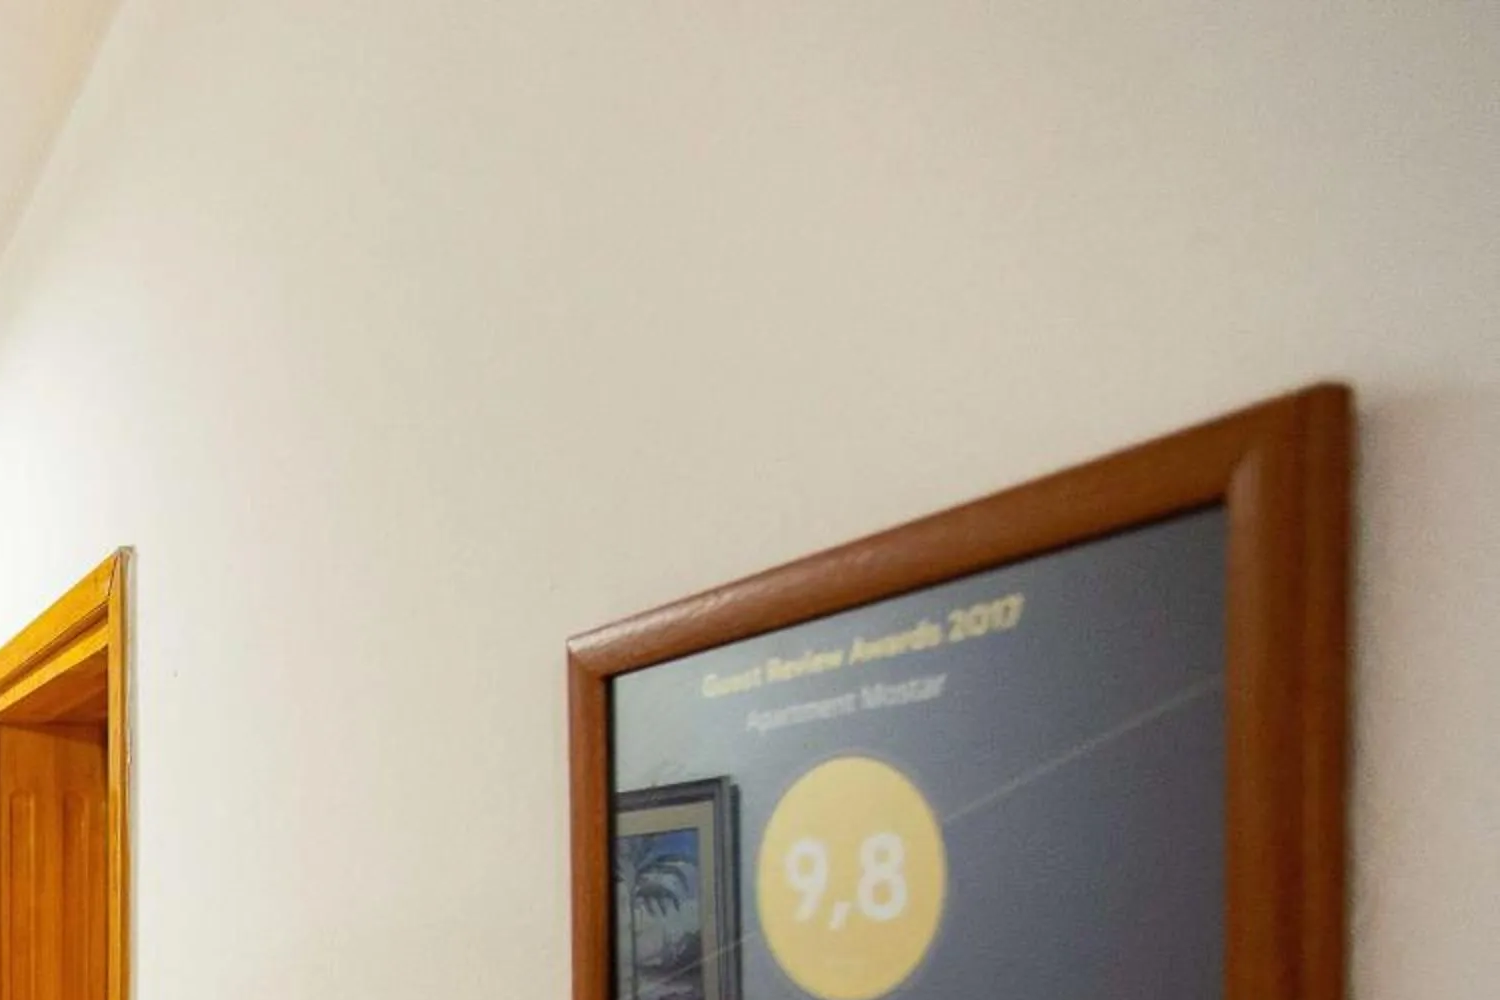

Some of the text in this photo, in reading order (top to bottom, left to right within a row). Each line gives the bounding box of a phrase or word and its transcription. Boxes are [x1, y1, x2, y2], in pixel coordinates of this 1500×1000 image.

[765, 650, 844, 683] Review
[849, 619, 943, 665] Awards
[947, 592, 1026, 643] 2017
[784, 832, 908, 931] 9,8
